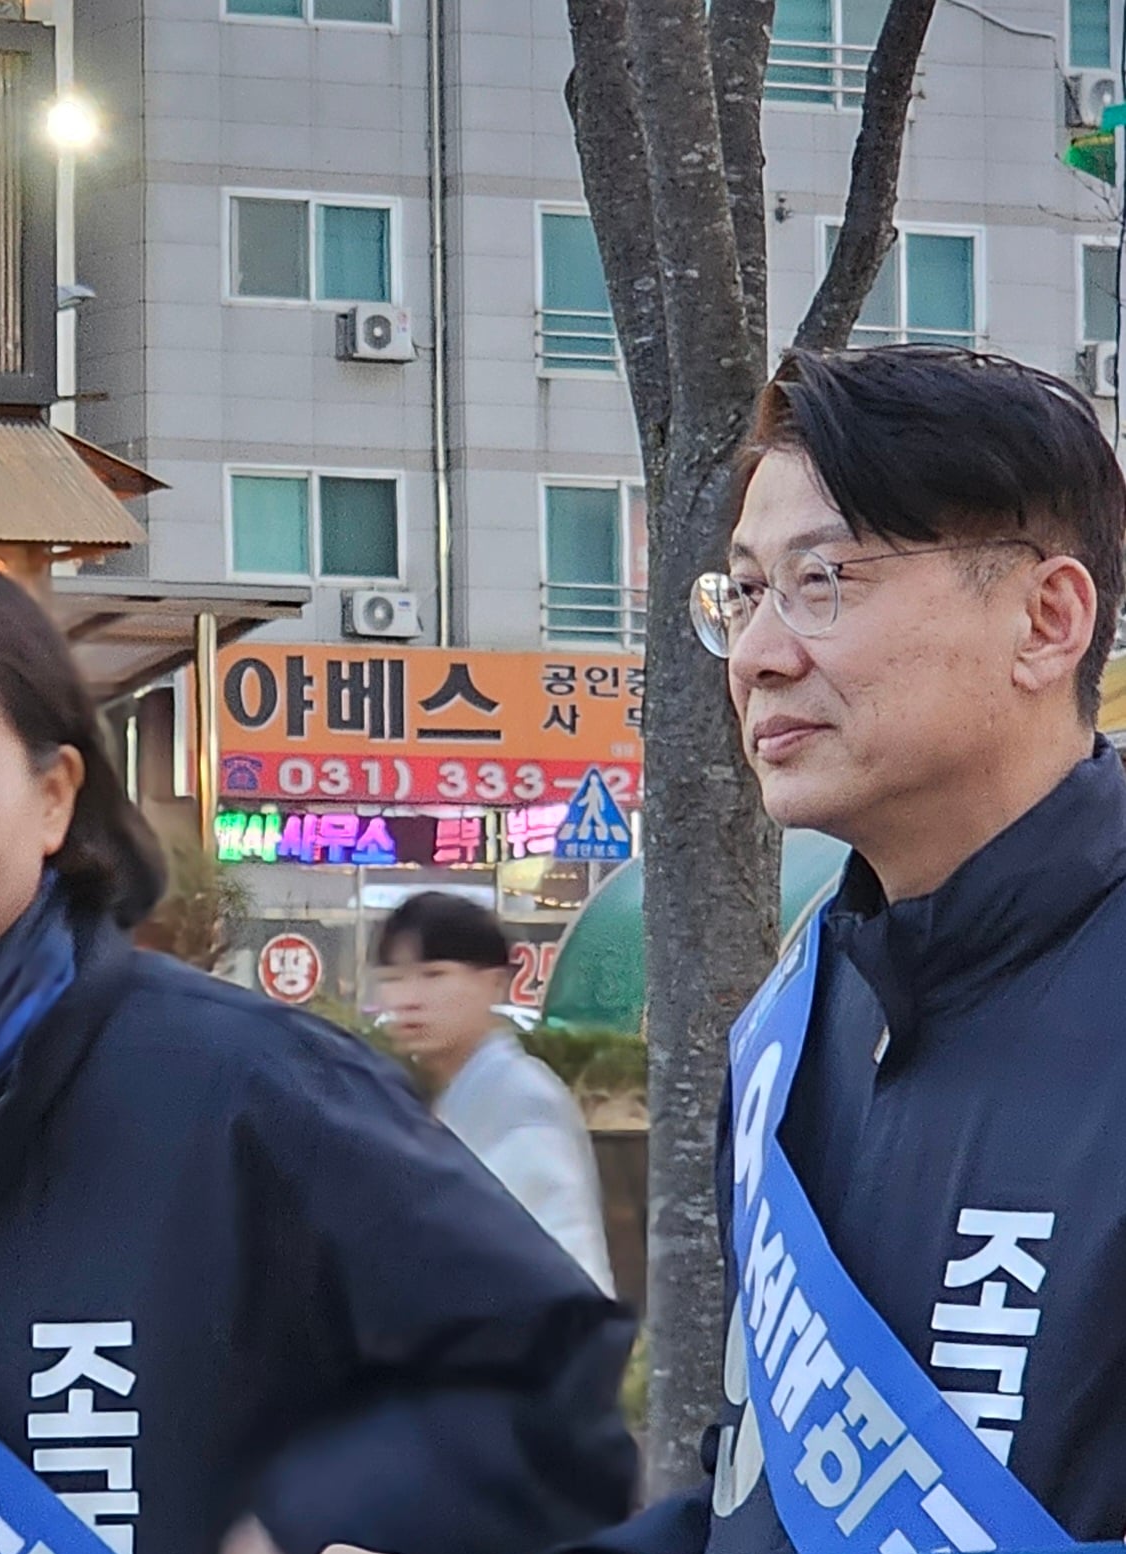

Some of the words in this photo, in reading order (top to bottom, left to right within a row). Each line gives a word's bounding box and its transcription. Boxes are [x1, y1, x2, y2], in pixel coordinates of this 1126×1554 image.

[224, 655, 503, 741] 야베스
[278, 758, 413, 800] 031)
[437, 759, 644, 803] 333-2
